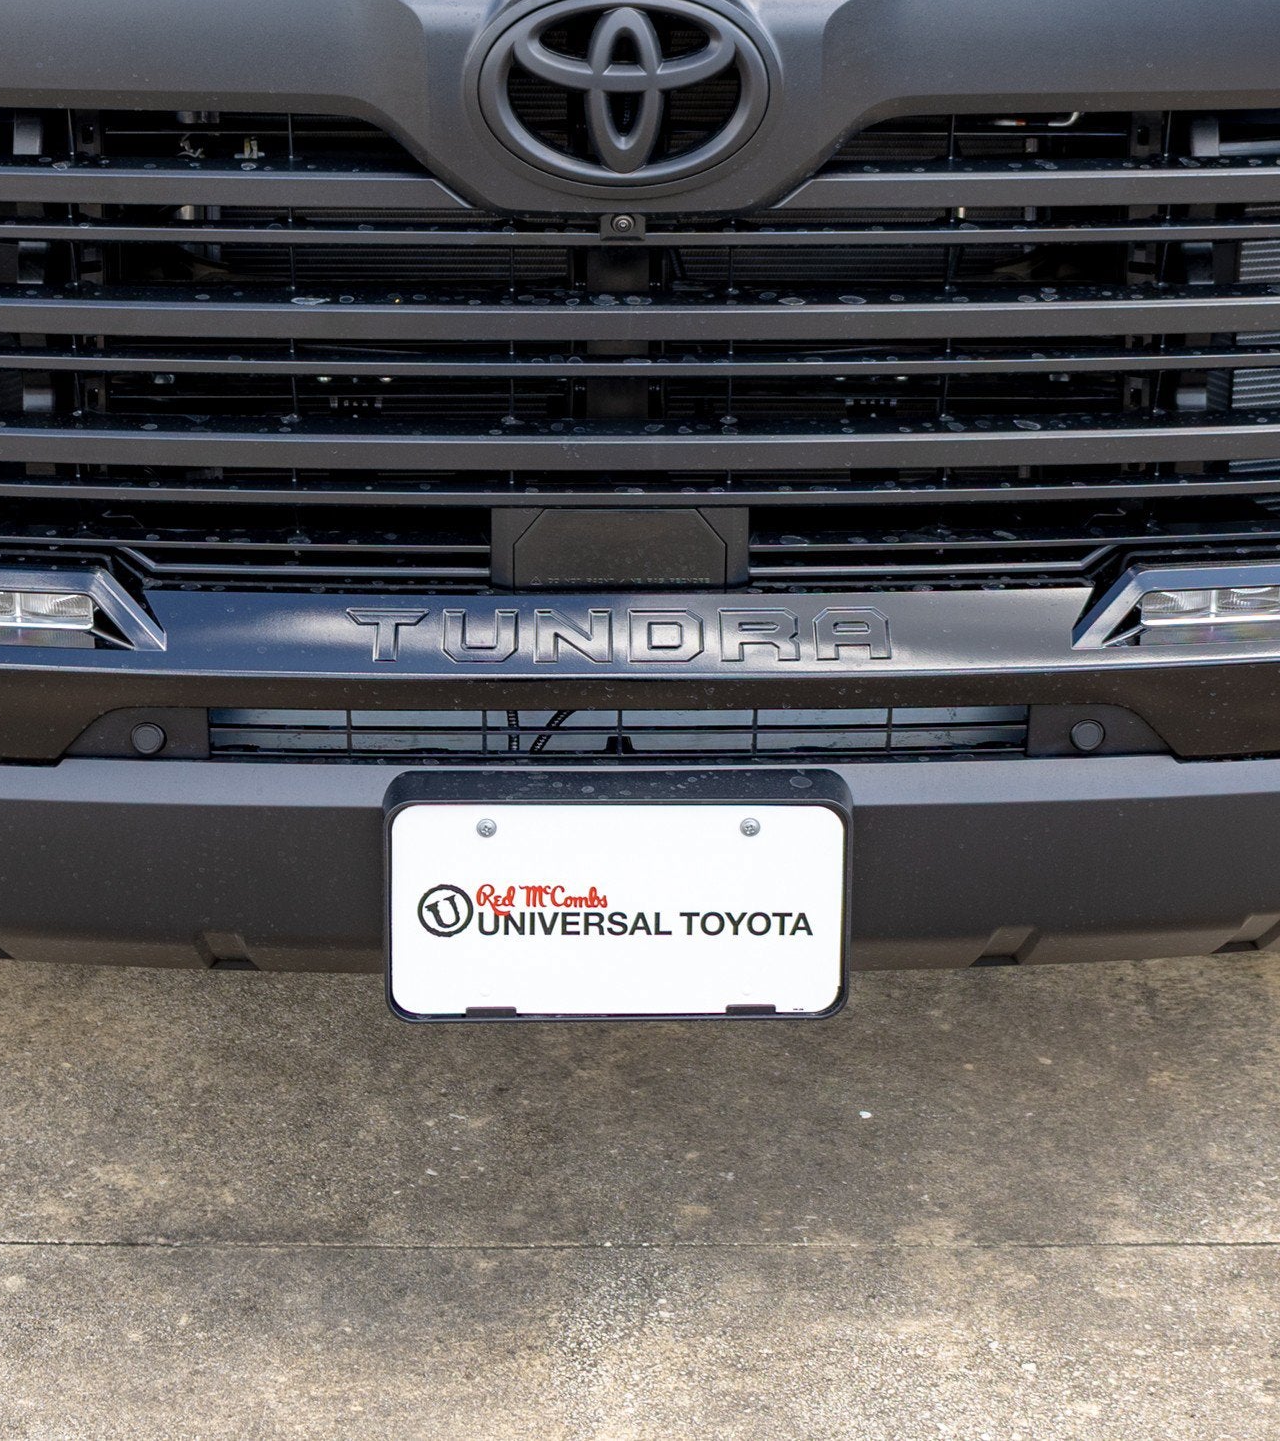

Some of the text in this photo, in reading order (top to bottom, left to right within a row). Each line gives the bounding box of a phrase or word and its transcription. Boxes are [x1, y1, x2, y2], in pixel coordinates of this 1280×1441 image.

[345, 607, 892, 664] TUNDRA
[476, 883, 608, 917] Red McCombs
[478, 911, 814, 936] UNIVERSAL TOYOTA
